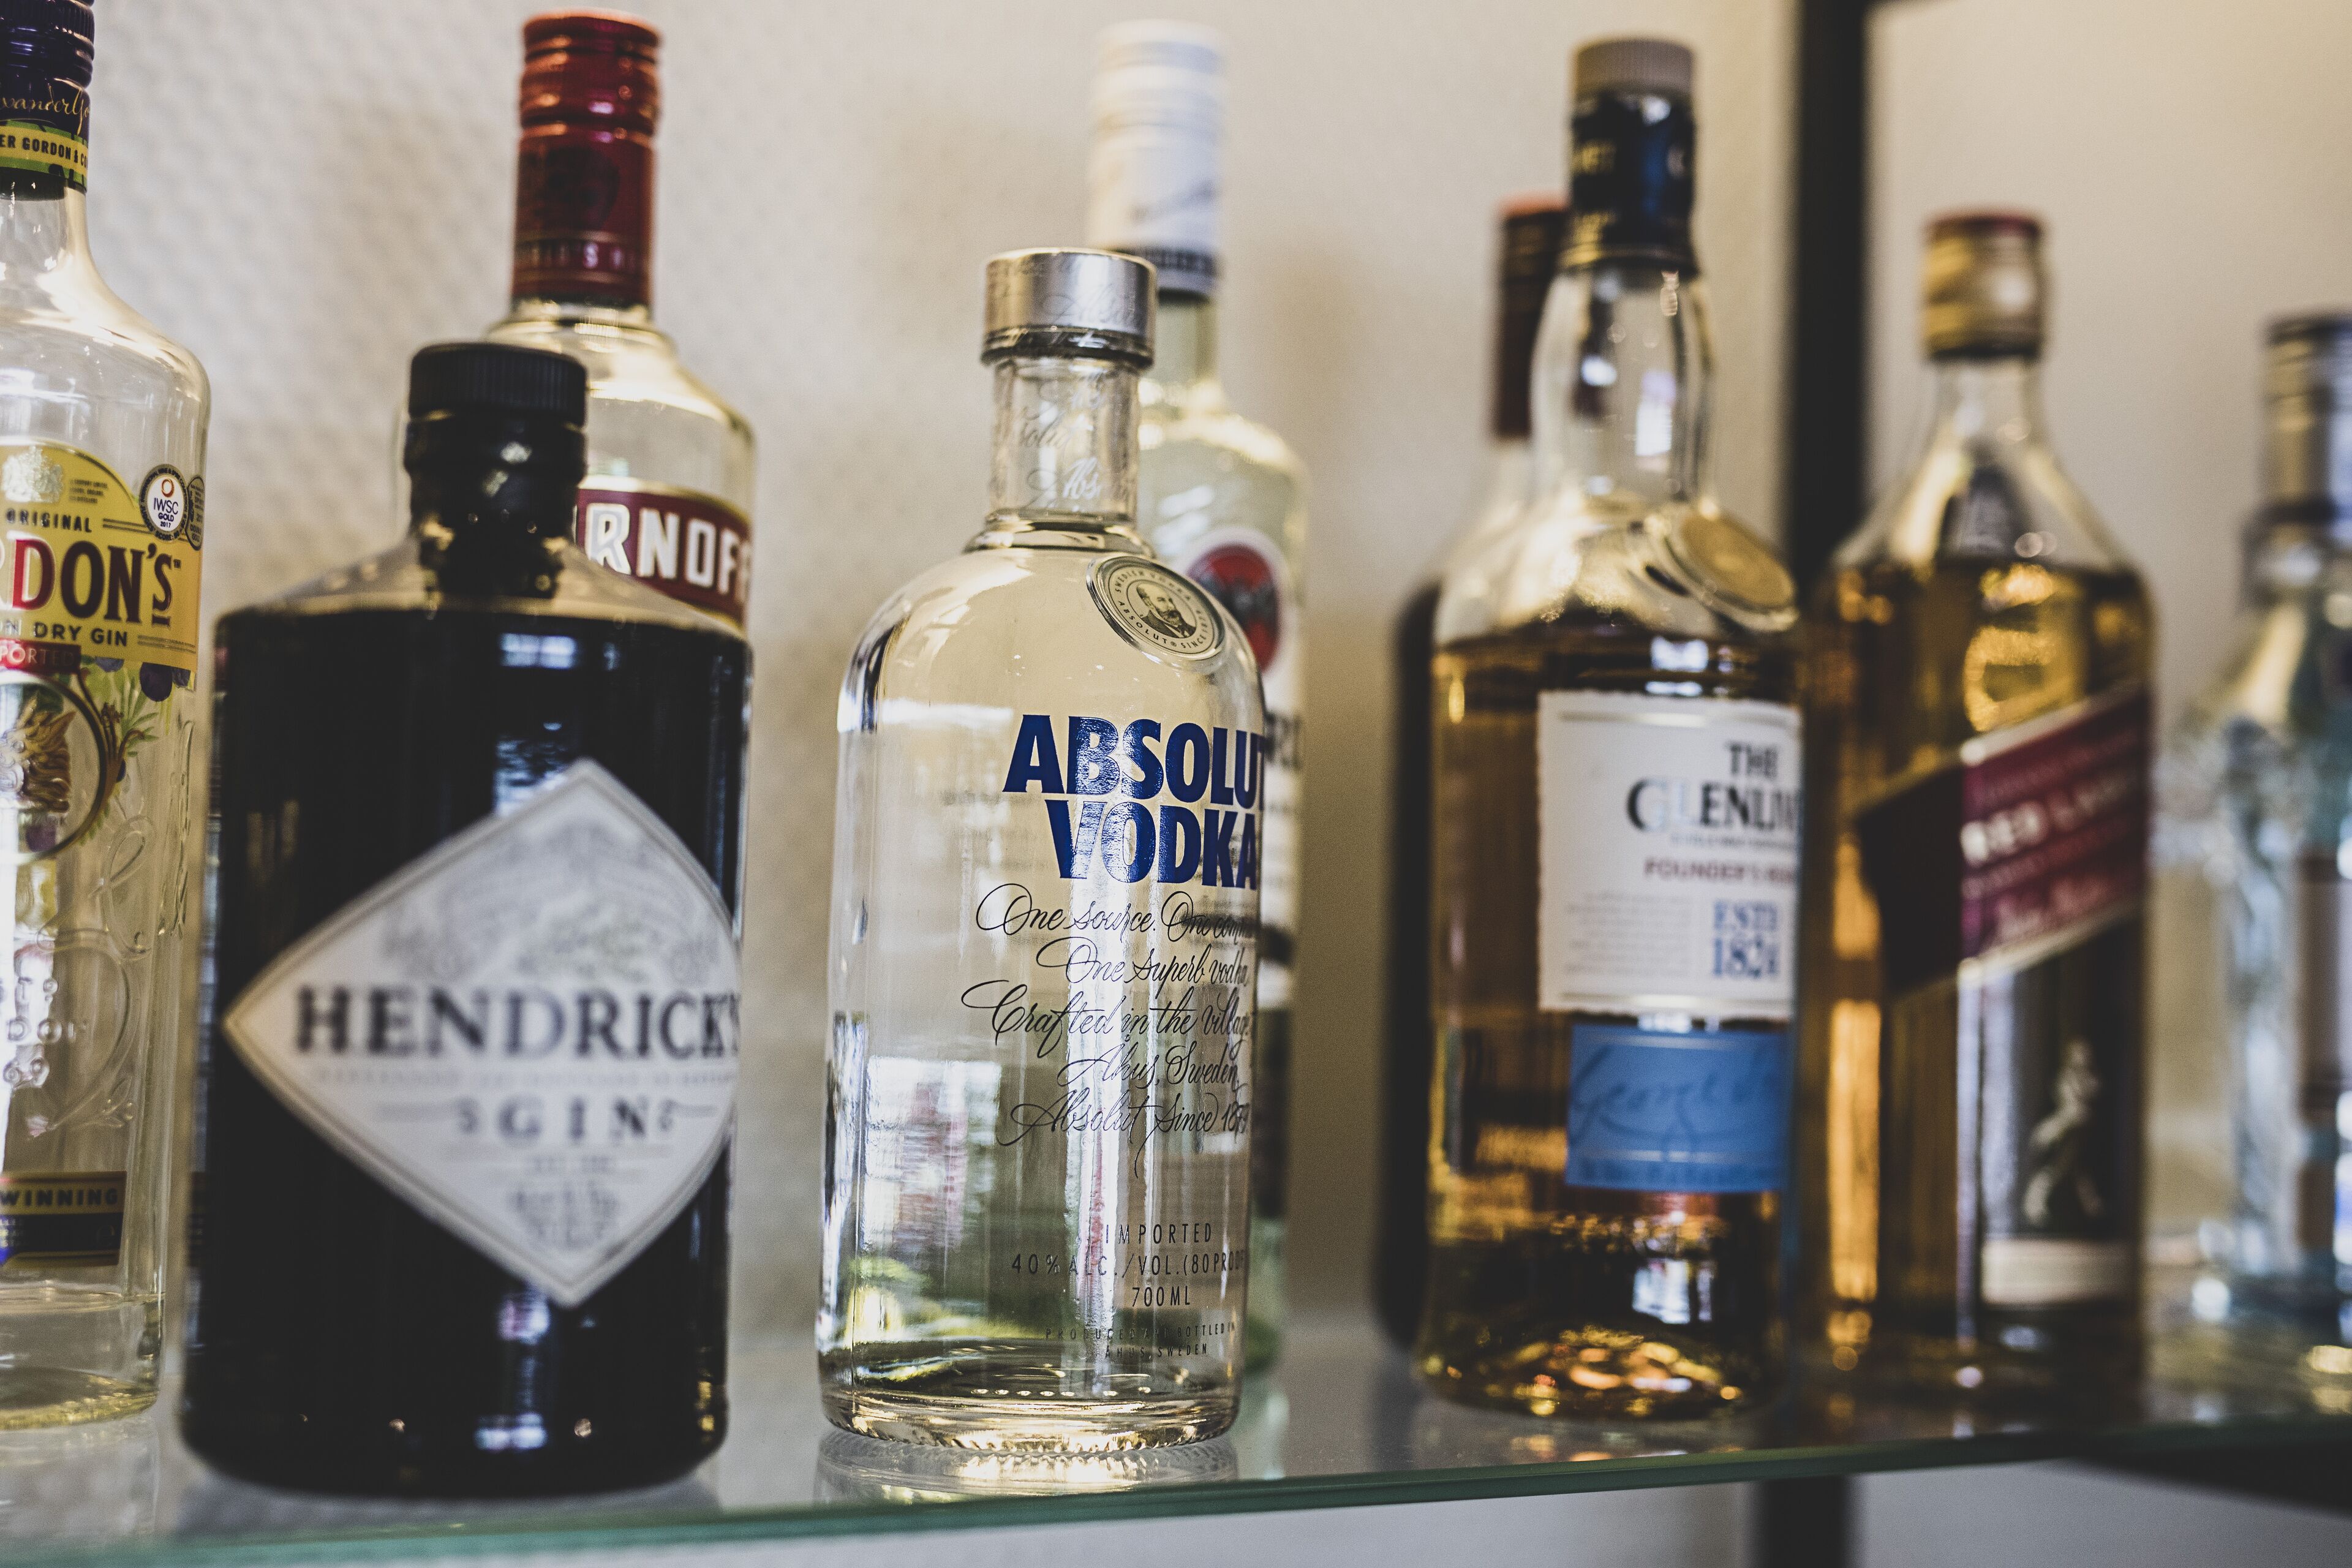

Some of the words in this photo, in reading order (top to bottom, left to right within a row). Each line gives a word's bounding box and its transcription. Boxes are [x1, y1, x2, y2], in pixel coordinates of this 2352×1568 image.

[22, 137, 72, 160] GORDON
[74, 149, 78, 164] &
[154, 497, 179, 515] IWSC
[158, 512, 175, 522] GOLD
[6, 508, 92, 533] ORIGINAL
[0, 533, 173, 628] DON'S
[1115, 569, 1144, 593] SWEDISH
[34, 621, 82, 641] DRY
[91, 627, 128, 647] GIN
[1180, 632, 1207, 649] SINCE
[1726, 740, 1779, 779] THE
[1045, 800, 1256, 891] VODKA
[976, 883, 1066, 936] One
[1064, 900, 1156, 943] source.
[1161, 891, 1212, 943] One
[1036, 937, 1125, 983] One
[961, 980, 1125, 1058] Crafted
[1120, 1009, 1150, 1035] in
[1149, 986, 1198, 1035] the
[498, 1096, 647, 1145] GIN
[996, 1086, 1163, 1145] Absolut
[1106, 1223, 1212, 1244] IMPORTED
[1012, 1253, 1060, 1275] 40%
[1132, 1286, 1191, 1307] 700ML
[1045, 1327, 1135, 1340] PRODUCED
[1142, 1327, 1169, 1340] AND
[1178, 1322, 1224, 1338] BOTTLED
[1158, 1343, 1207, 1358] SWEDEN
